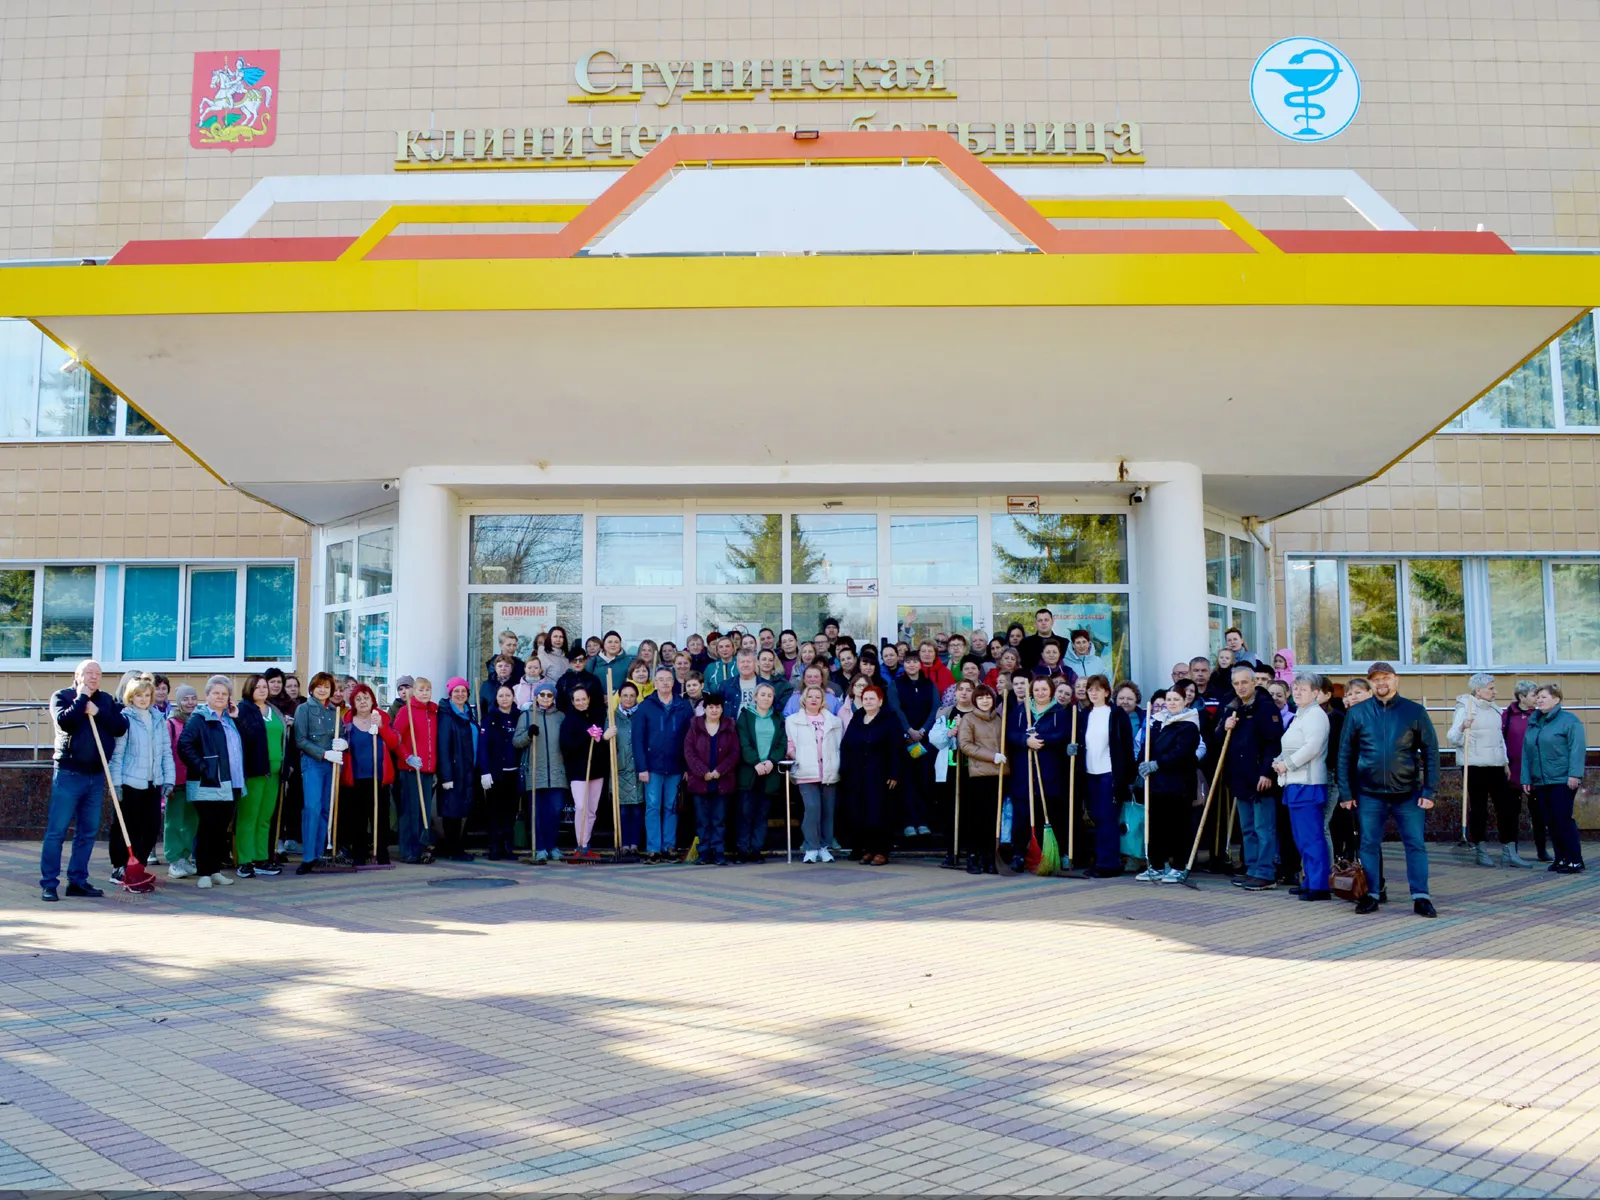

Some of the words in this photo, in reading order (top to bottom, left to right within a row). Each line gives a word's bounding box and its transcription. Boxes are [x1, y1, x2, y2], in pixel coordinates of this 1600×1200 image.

[574, 48, 947, 107] Ступинская
[394, 123, 797, 162] клиниче
[849, 108, 1144, 162] бьница
[501, 605, 548, 616] ПОМНИМ!
